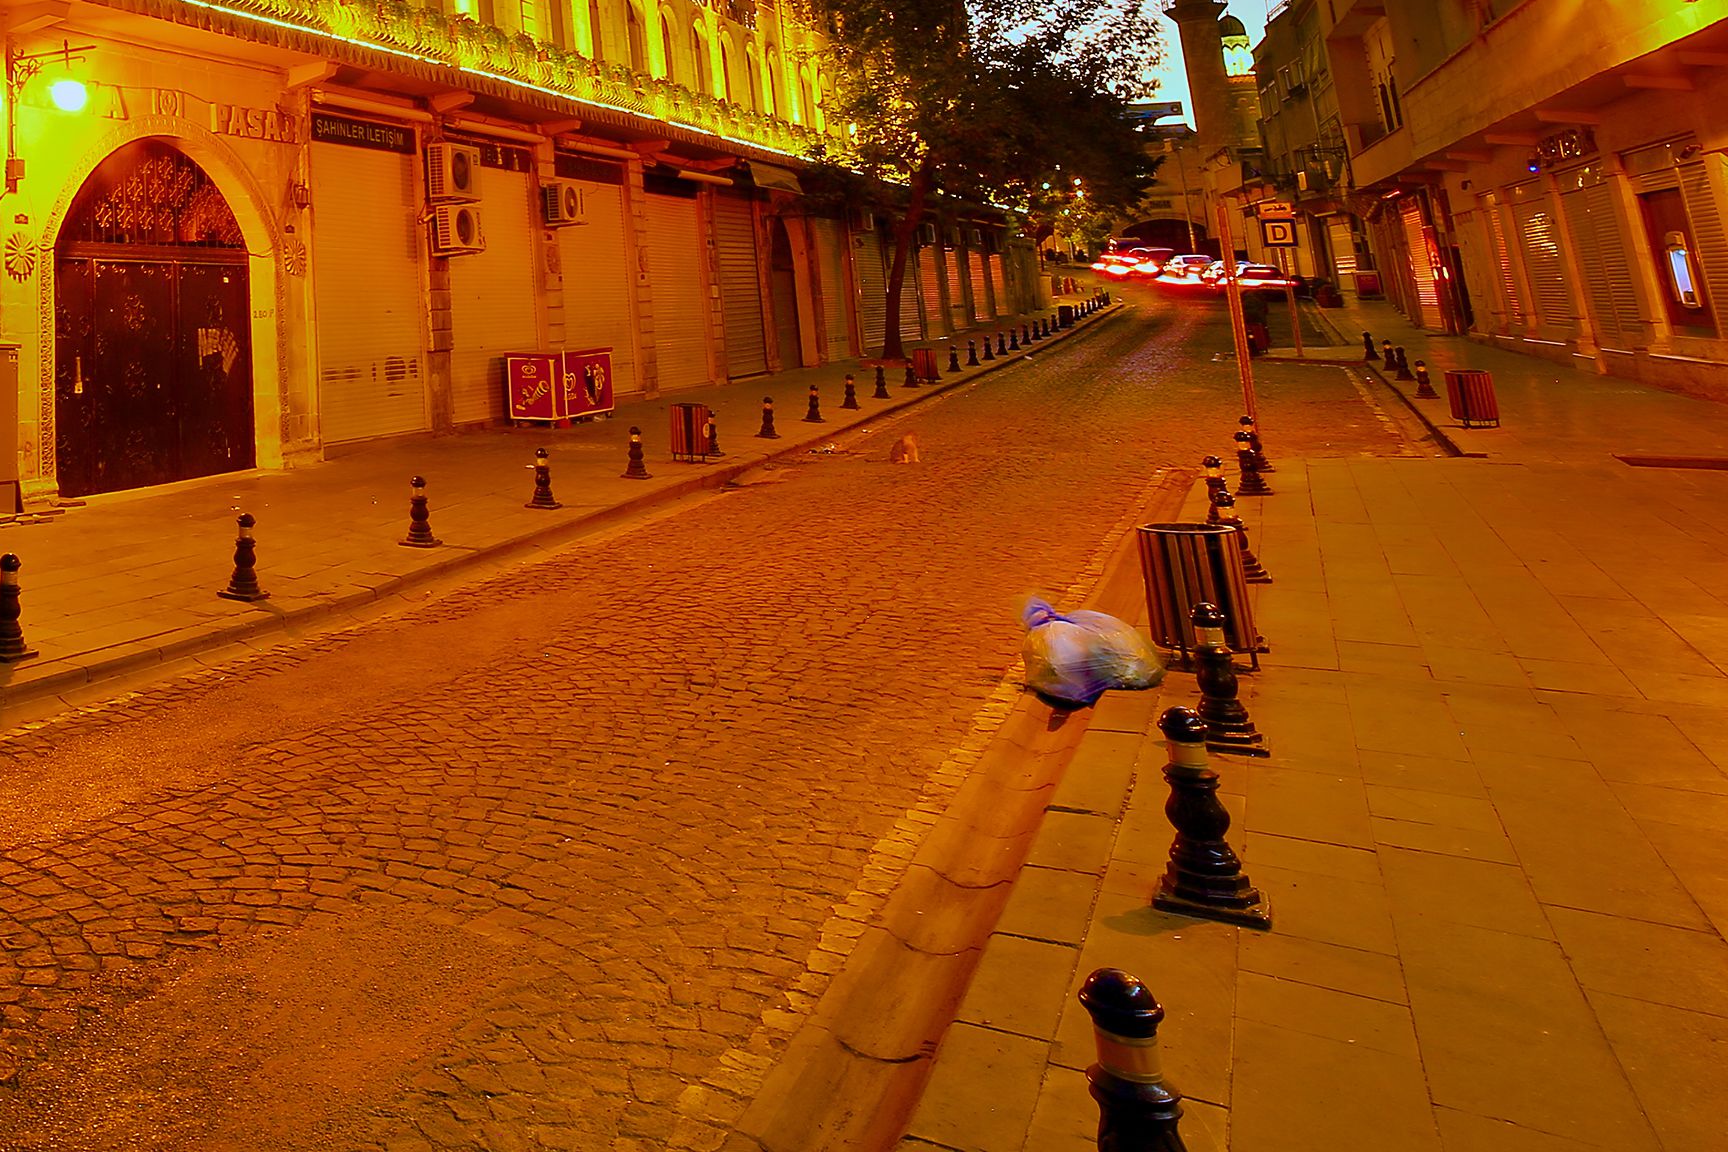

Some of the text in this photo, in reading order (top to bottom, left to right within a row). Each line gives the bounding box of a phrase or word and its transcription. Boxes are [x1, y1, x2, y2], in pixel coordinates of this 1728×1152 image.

[316, 118, 404, 148] ŞAHİNLER İLETİŞİM
[1271, 225, 1287, 241] D
